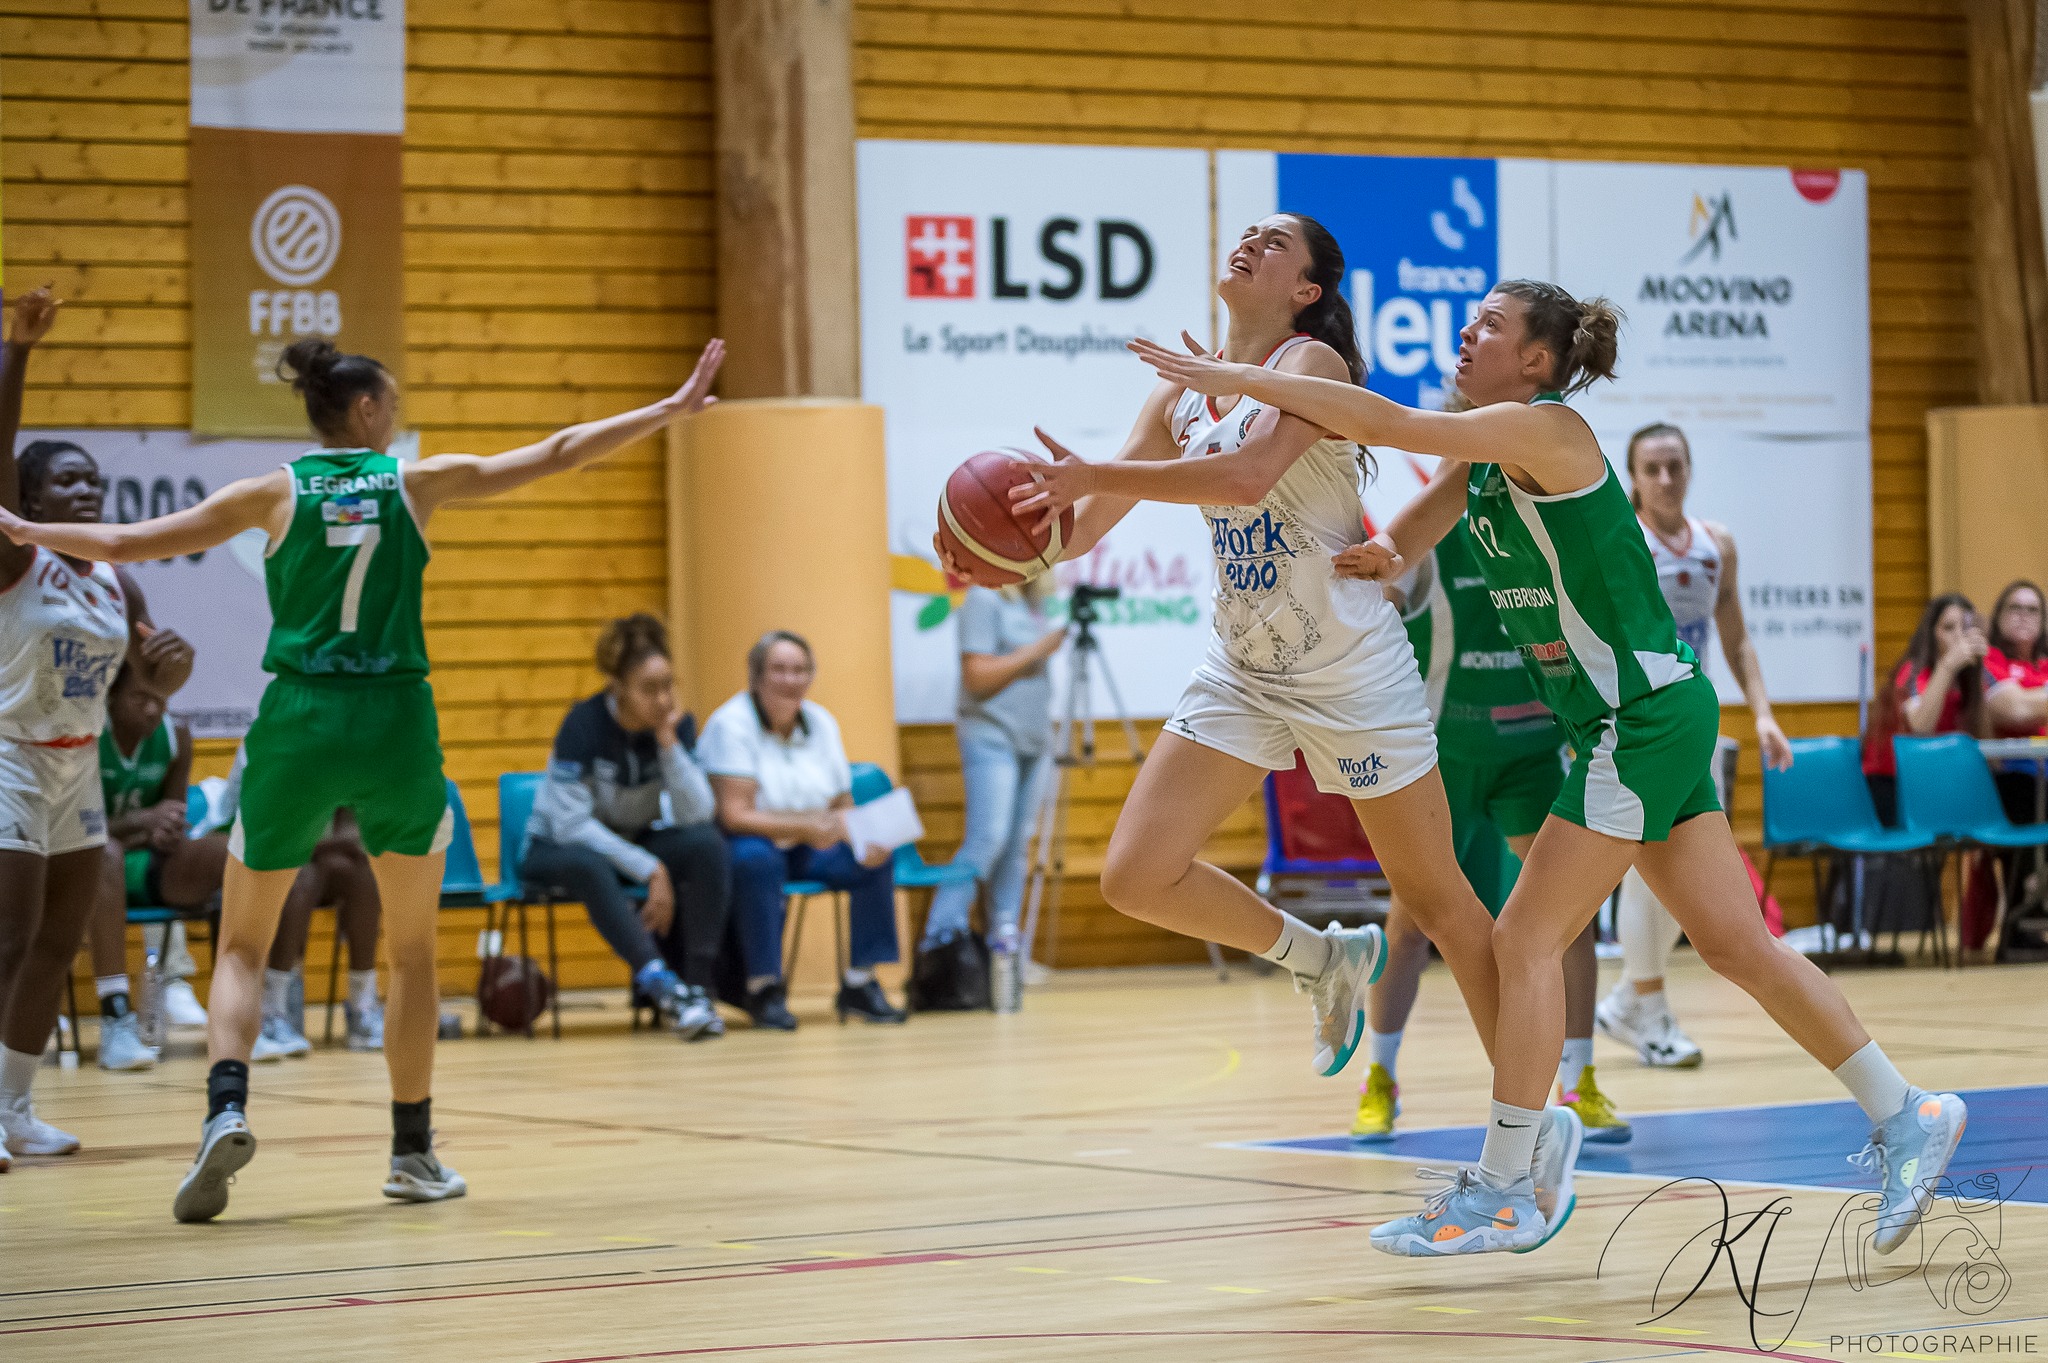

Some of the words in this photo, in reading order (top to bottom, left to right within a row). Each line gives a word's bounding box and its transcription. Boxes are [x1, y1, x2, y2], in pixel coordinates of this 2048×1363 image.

[990, 216, 1155, 300] LSD
[1352, 268, 1482, 375] leu
[1663, 310, 1769, 339] ARENA
[939, 325, 1008, 362] Sport
[296, 472, 400, 496] LEGRAND
[1468, 515, 1512, 559] 12
[325, 523, 382, 633] 7
[1489, 586, 1555, 610] ONTBRISON
[1336, 752, 1389, 775] Work
[1349, 772, 1379, 788] 2000
